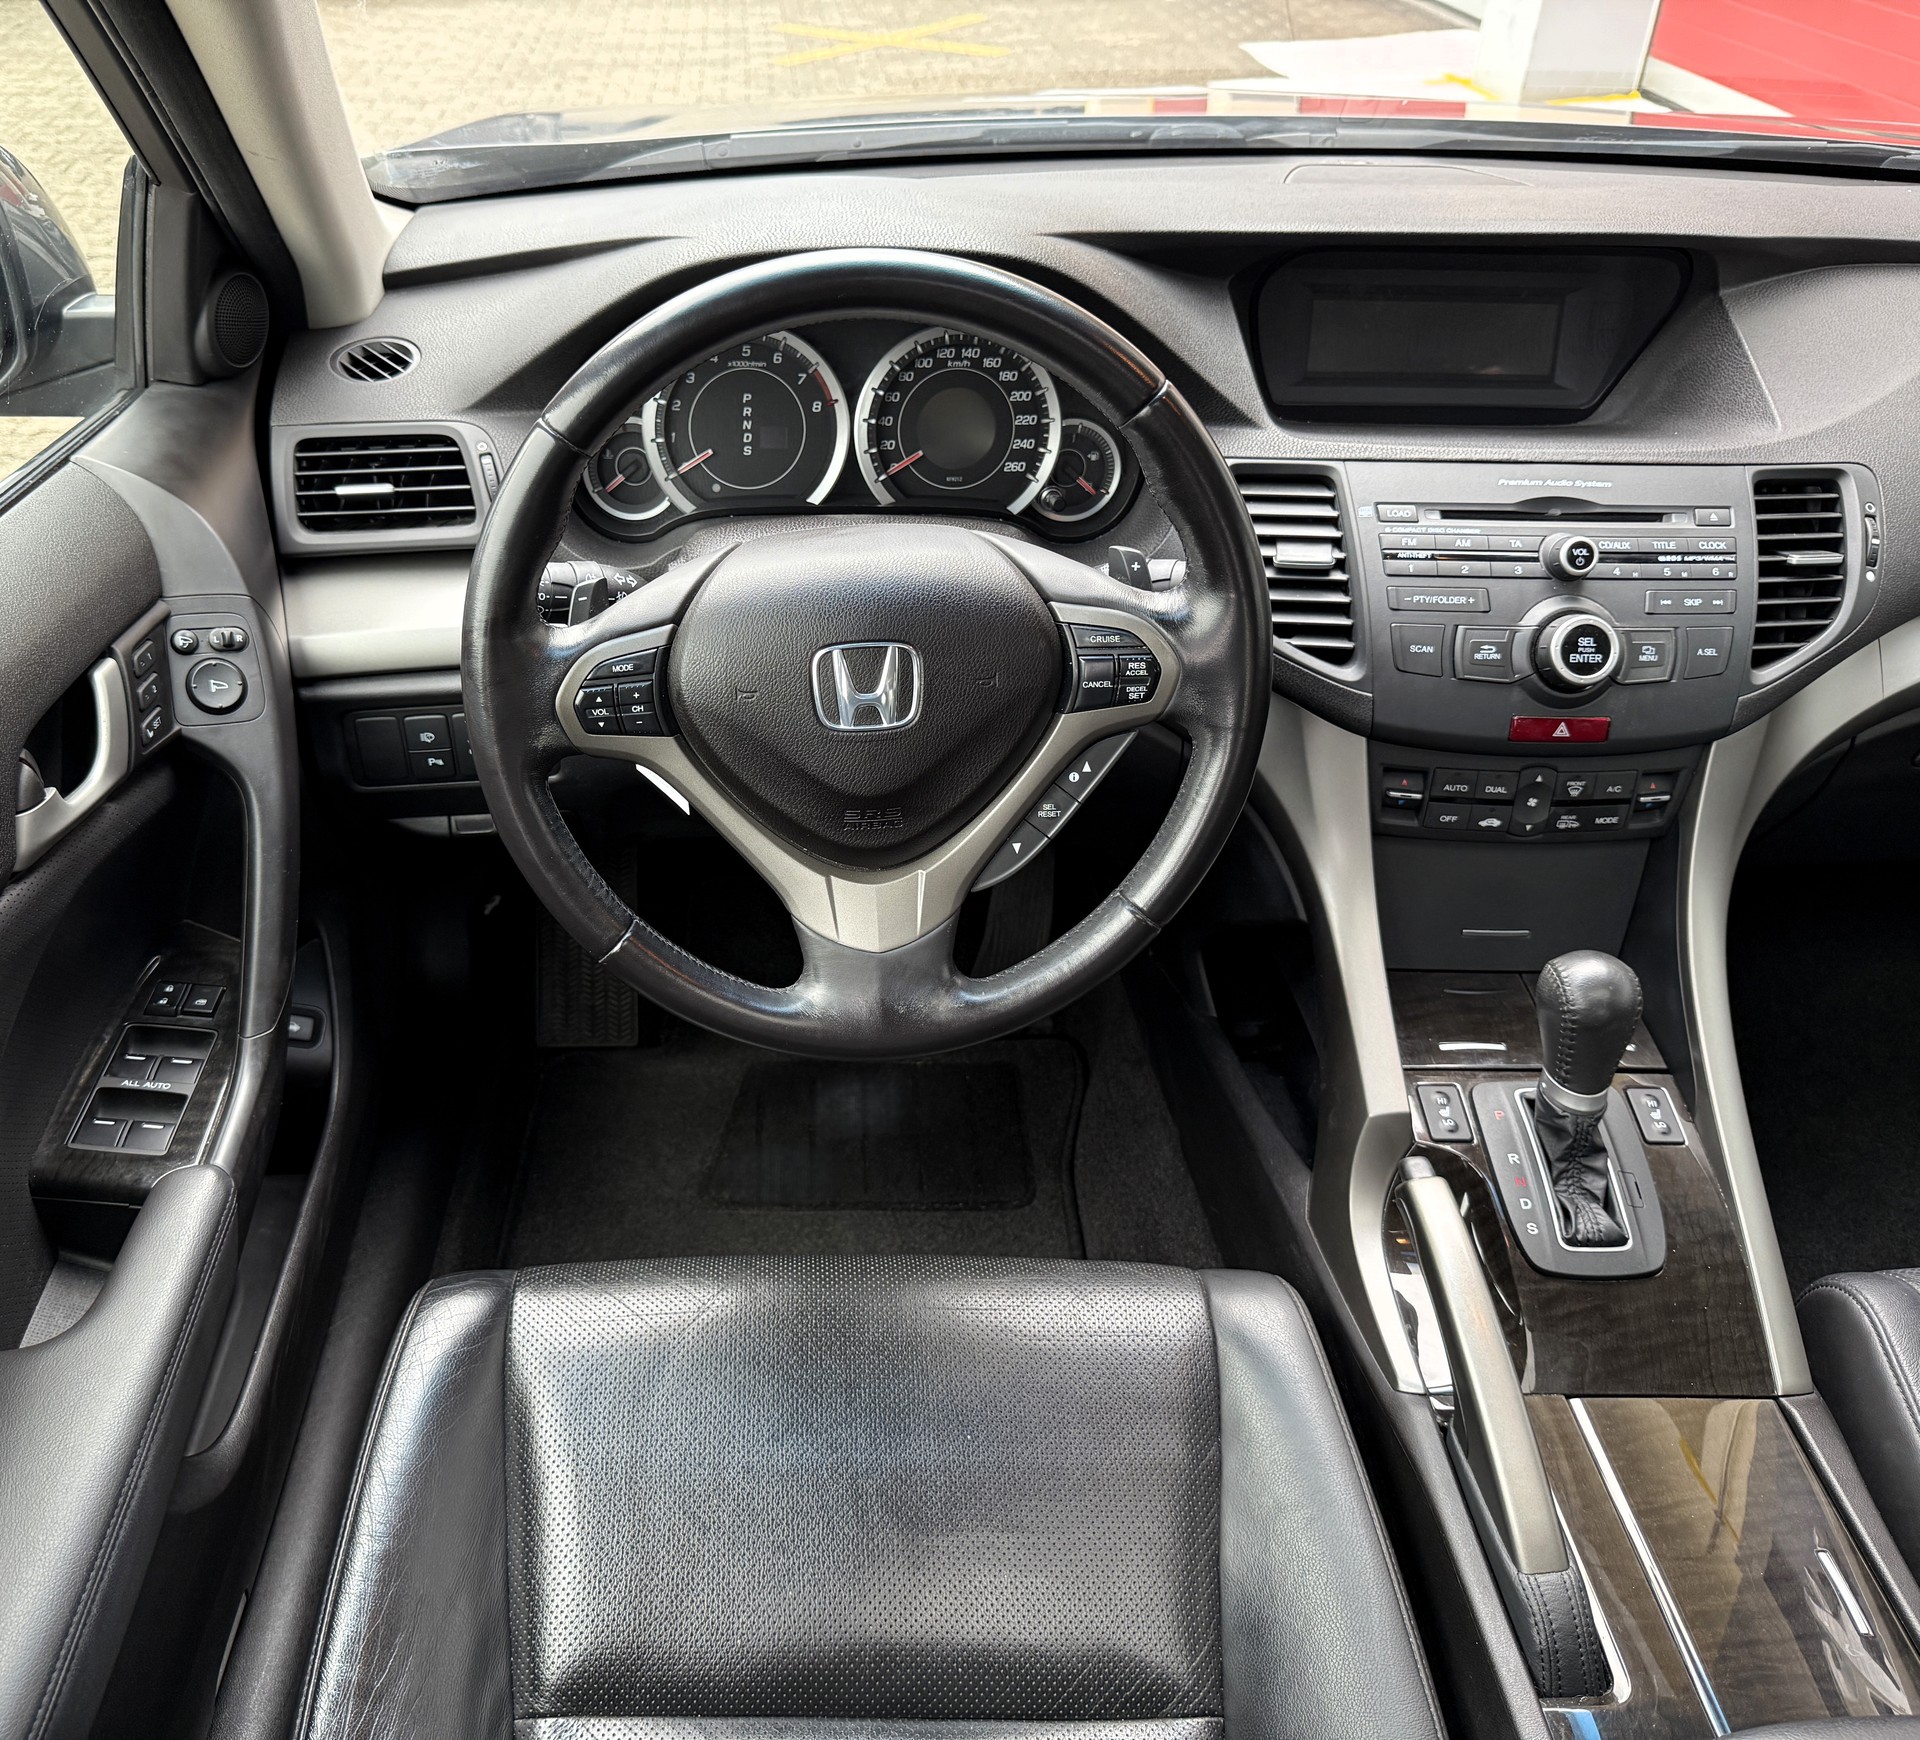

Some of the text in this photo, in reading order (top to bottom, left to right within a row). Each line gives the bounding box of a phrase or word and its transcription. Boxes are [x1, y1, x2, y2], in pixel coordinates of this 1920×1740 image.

[742, 346, 751, 356] 5
[937, 348, 955, 358] 120
[961, 348, 980, 358] 140
[773, 353, 782, 363] 6
[915, 358, 933, 368] 100
[982, 358, 1001, 368] 160
[686, 372, 695, 383] 3
[798, 374, 807, 384] 7
[898, 372, 914, 382] 80
[999, 371, 1018, 381] 180
[743, 393, 752, 403] P
[884, 392, 900, 402] 60
[1010, 391, 1032, 401] 200
[671, 400, 681, 411] 2
[812, 401, 822, 412] 8
[743, 407, 752, 416] R
[742, 420, 752, 430] N
[878, 417, 893, 426] 40
[1015, 415, 1037, 425] 220
[671, 432, 676, 443] 1
[743, 433, 752, 443] D
[880, 440, 895, 450] 20
[1013, 439, 1035, 449] 240
[743, 446, 752, 455] S
[1004, 462, 1026, 472] 260
[1386, 509, 1412, 518] LOAD
[1598, 541, 1630, 549] CD/AUX
[1461, 566, 1469, 574] 2
[1514, 566, 1522, 574] 3
[1664, 568, 1671, 576] 5
[1712, 568, 1719, 576] 6
[1578, 638, 1597, 646] SEL
[1570, 654, 1602, 663] ENTER
[612, 664, 634, 672] MODE
[1443, 784, 1468, 792] AUTO
[1485, 785, 1507, 794] DUAL
[1606, 785, 1622, 793] A/C
[844, 807, 901, 819] SRS
[1595, 816, 1619, 824] MODE
[844, 820, 903, 831] AIRBAG
[1494, 1110, 1504, 1120] P
[1507, 1153, 1520, 1164] R
[1515, 1177, 1528, 1187] N
[1520, 1198, 1532, 1209] D
[1527, 1223, 1539, 1235] S
